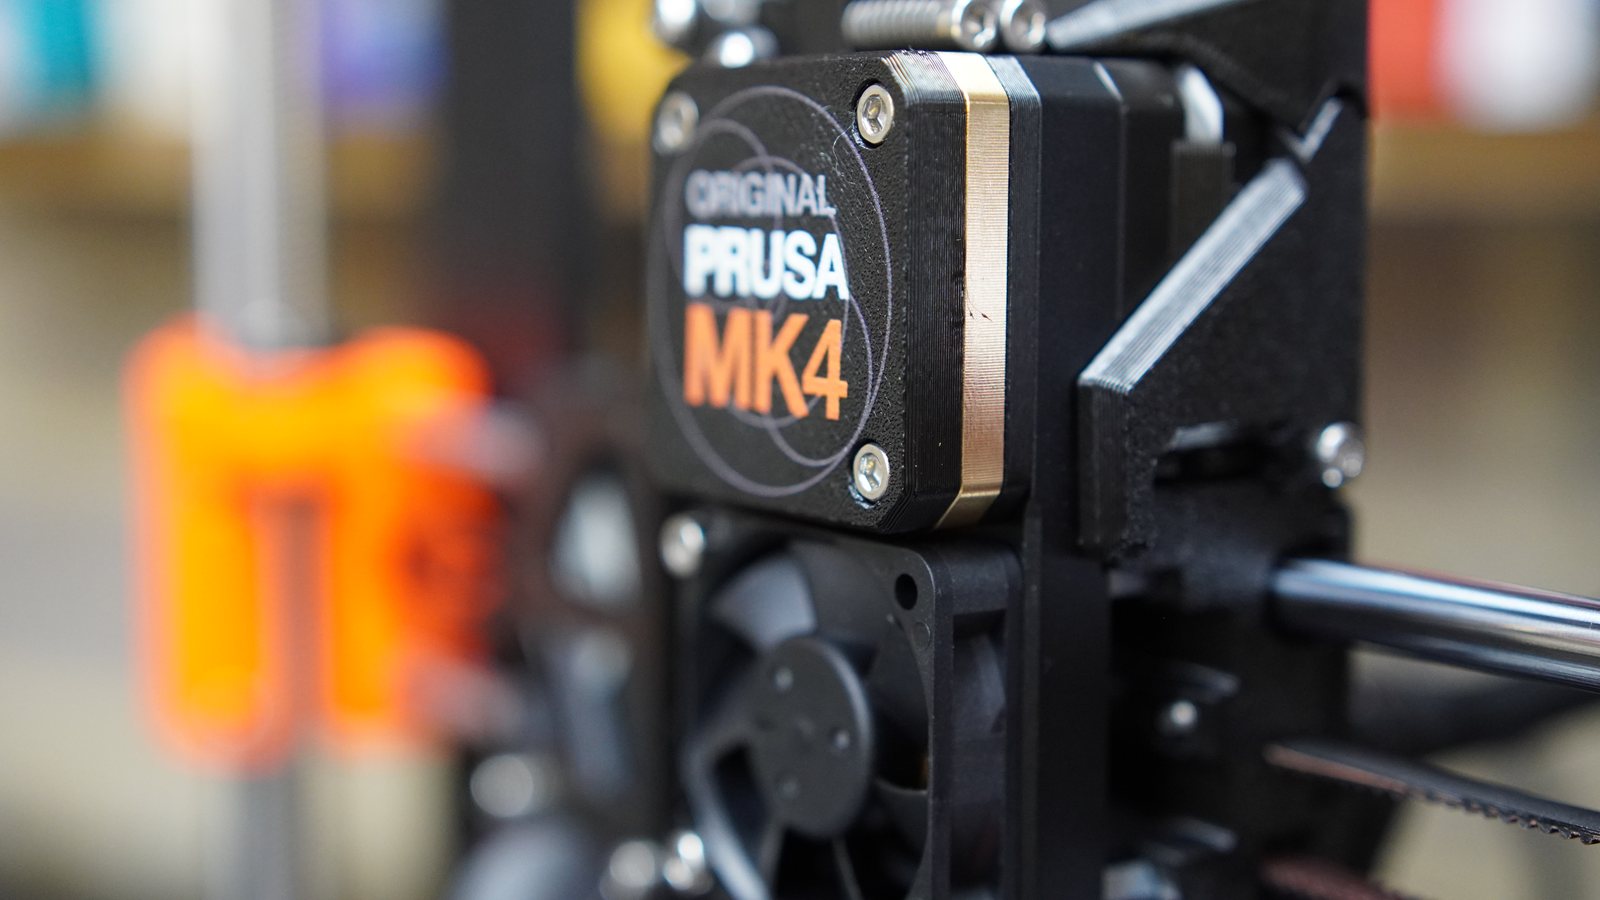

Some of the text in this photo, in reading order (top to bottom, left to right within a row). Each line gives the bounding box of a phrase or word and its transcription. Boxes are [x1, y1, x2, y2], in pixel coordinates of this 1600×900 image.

[686, 169, 836, 217] ORIGINAL
[684, 224, 849, 299] PRUSA
[684, 303, 848, 420] MK4
